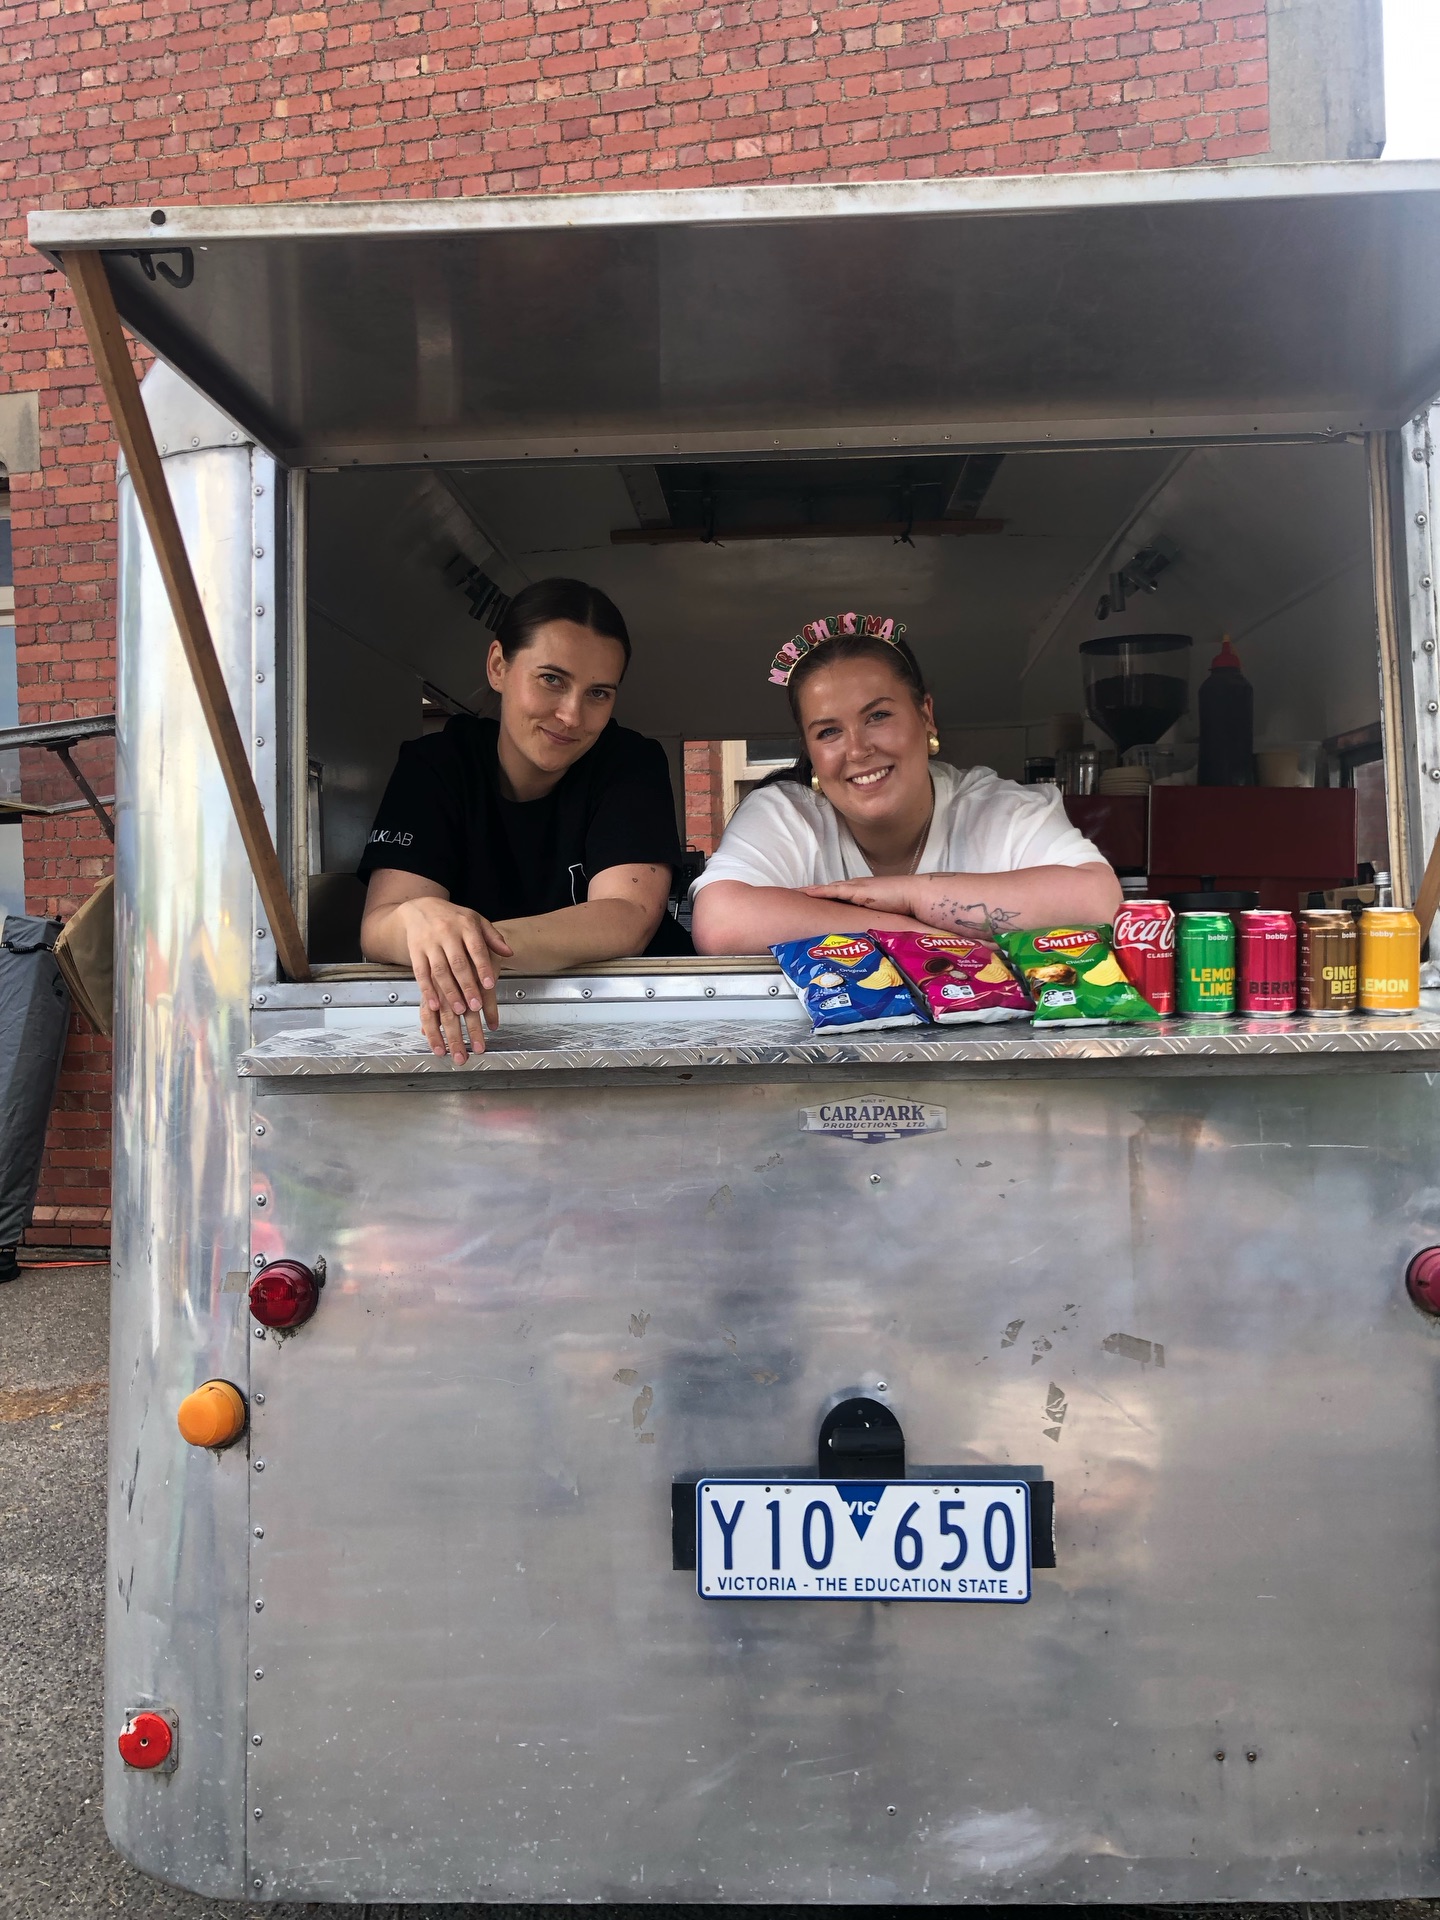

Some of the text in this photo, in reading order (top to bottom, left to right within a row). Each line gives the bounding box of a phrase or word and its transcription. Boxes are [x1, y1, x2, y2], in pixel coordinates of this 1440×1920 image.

[768, 612, 906, 686] MERRY CHRISTMAS
[368, 830, 413, 846] ILKLAB
[1113, 905, 1175, 951] Coca-C
[1370, 930, 1394, 938] bobby
[812, 941, 869, 956] SMITH'S
[1037, 932, 1098, 949] SMITH'S
[1322, 965, 1356, 981] GING
[1200, 982, 1233, 996] LIME
[1331, 979, 1357, 995] BEE
[819, 1105, 925, 1121] CARAPARK
[843, 1501, 877, 1516] VIC
[711, 1500, 1016, 1572] Y10 650
[717, 1577, 797, 1591] VICTORIA
[815, 1577, 848, 1592] THE
[854, 1578, 951, 1593] EDUCATION
[958, 1579, 1008, 1593] STATE
